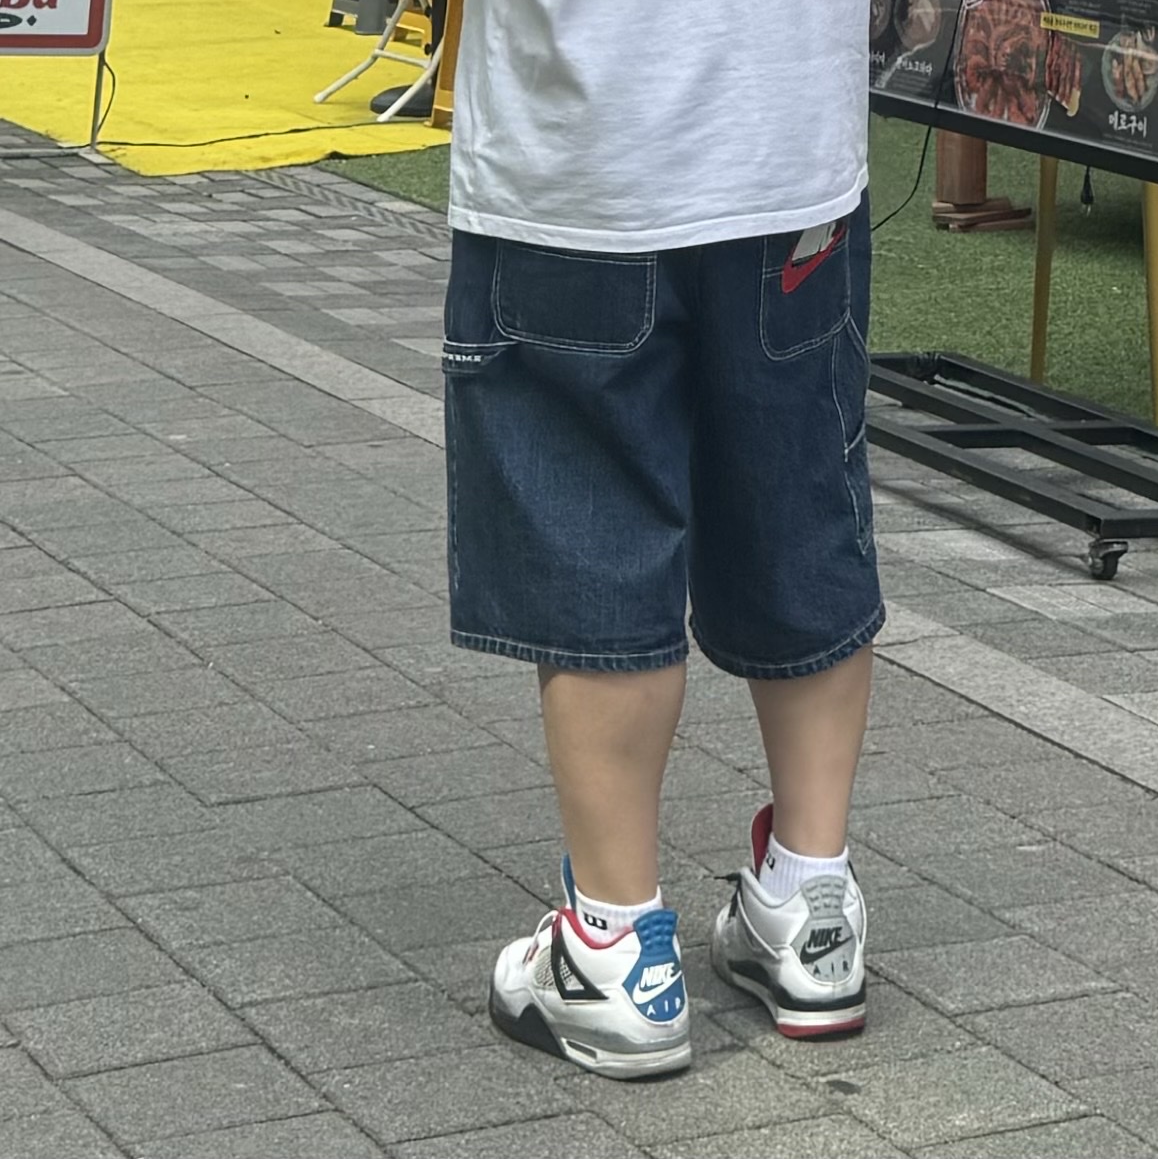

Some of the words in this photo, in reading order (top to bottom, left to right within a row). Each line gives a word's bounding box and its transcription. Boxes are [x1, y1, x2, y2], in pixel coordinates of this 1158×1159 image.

[1108, 110, 1147, 138] 메로구이
[806, 925, 843, 951] NIKE
[640, 963, 676, 989] NIKE
[812, 959, 851, 977] AIR
[646, 997, 685, 1017] AIR
